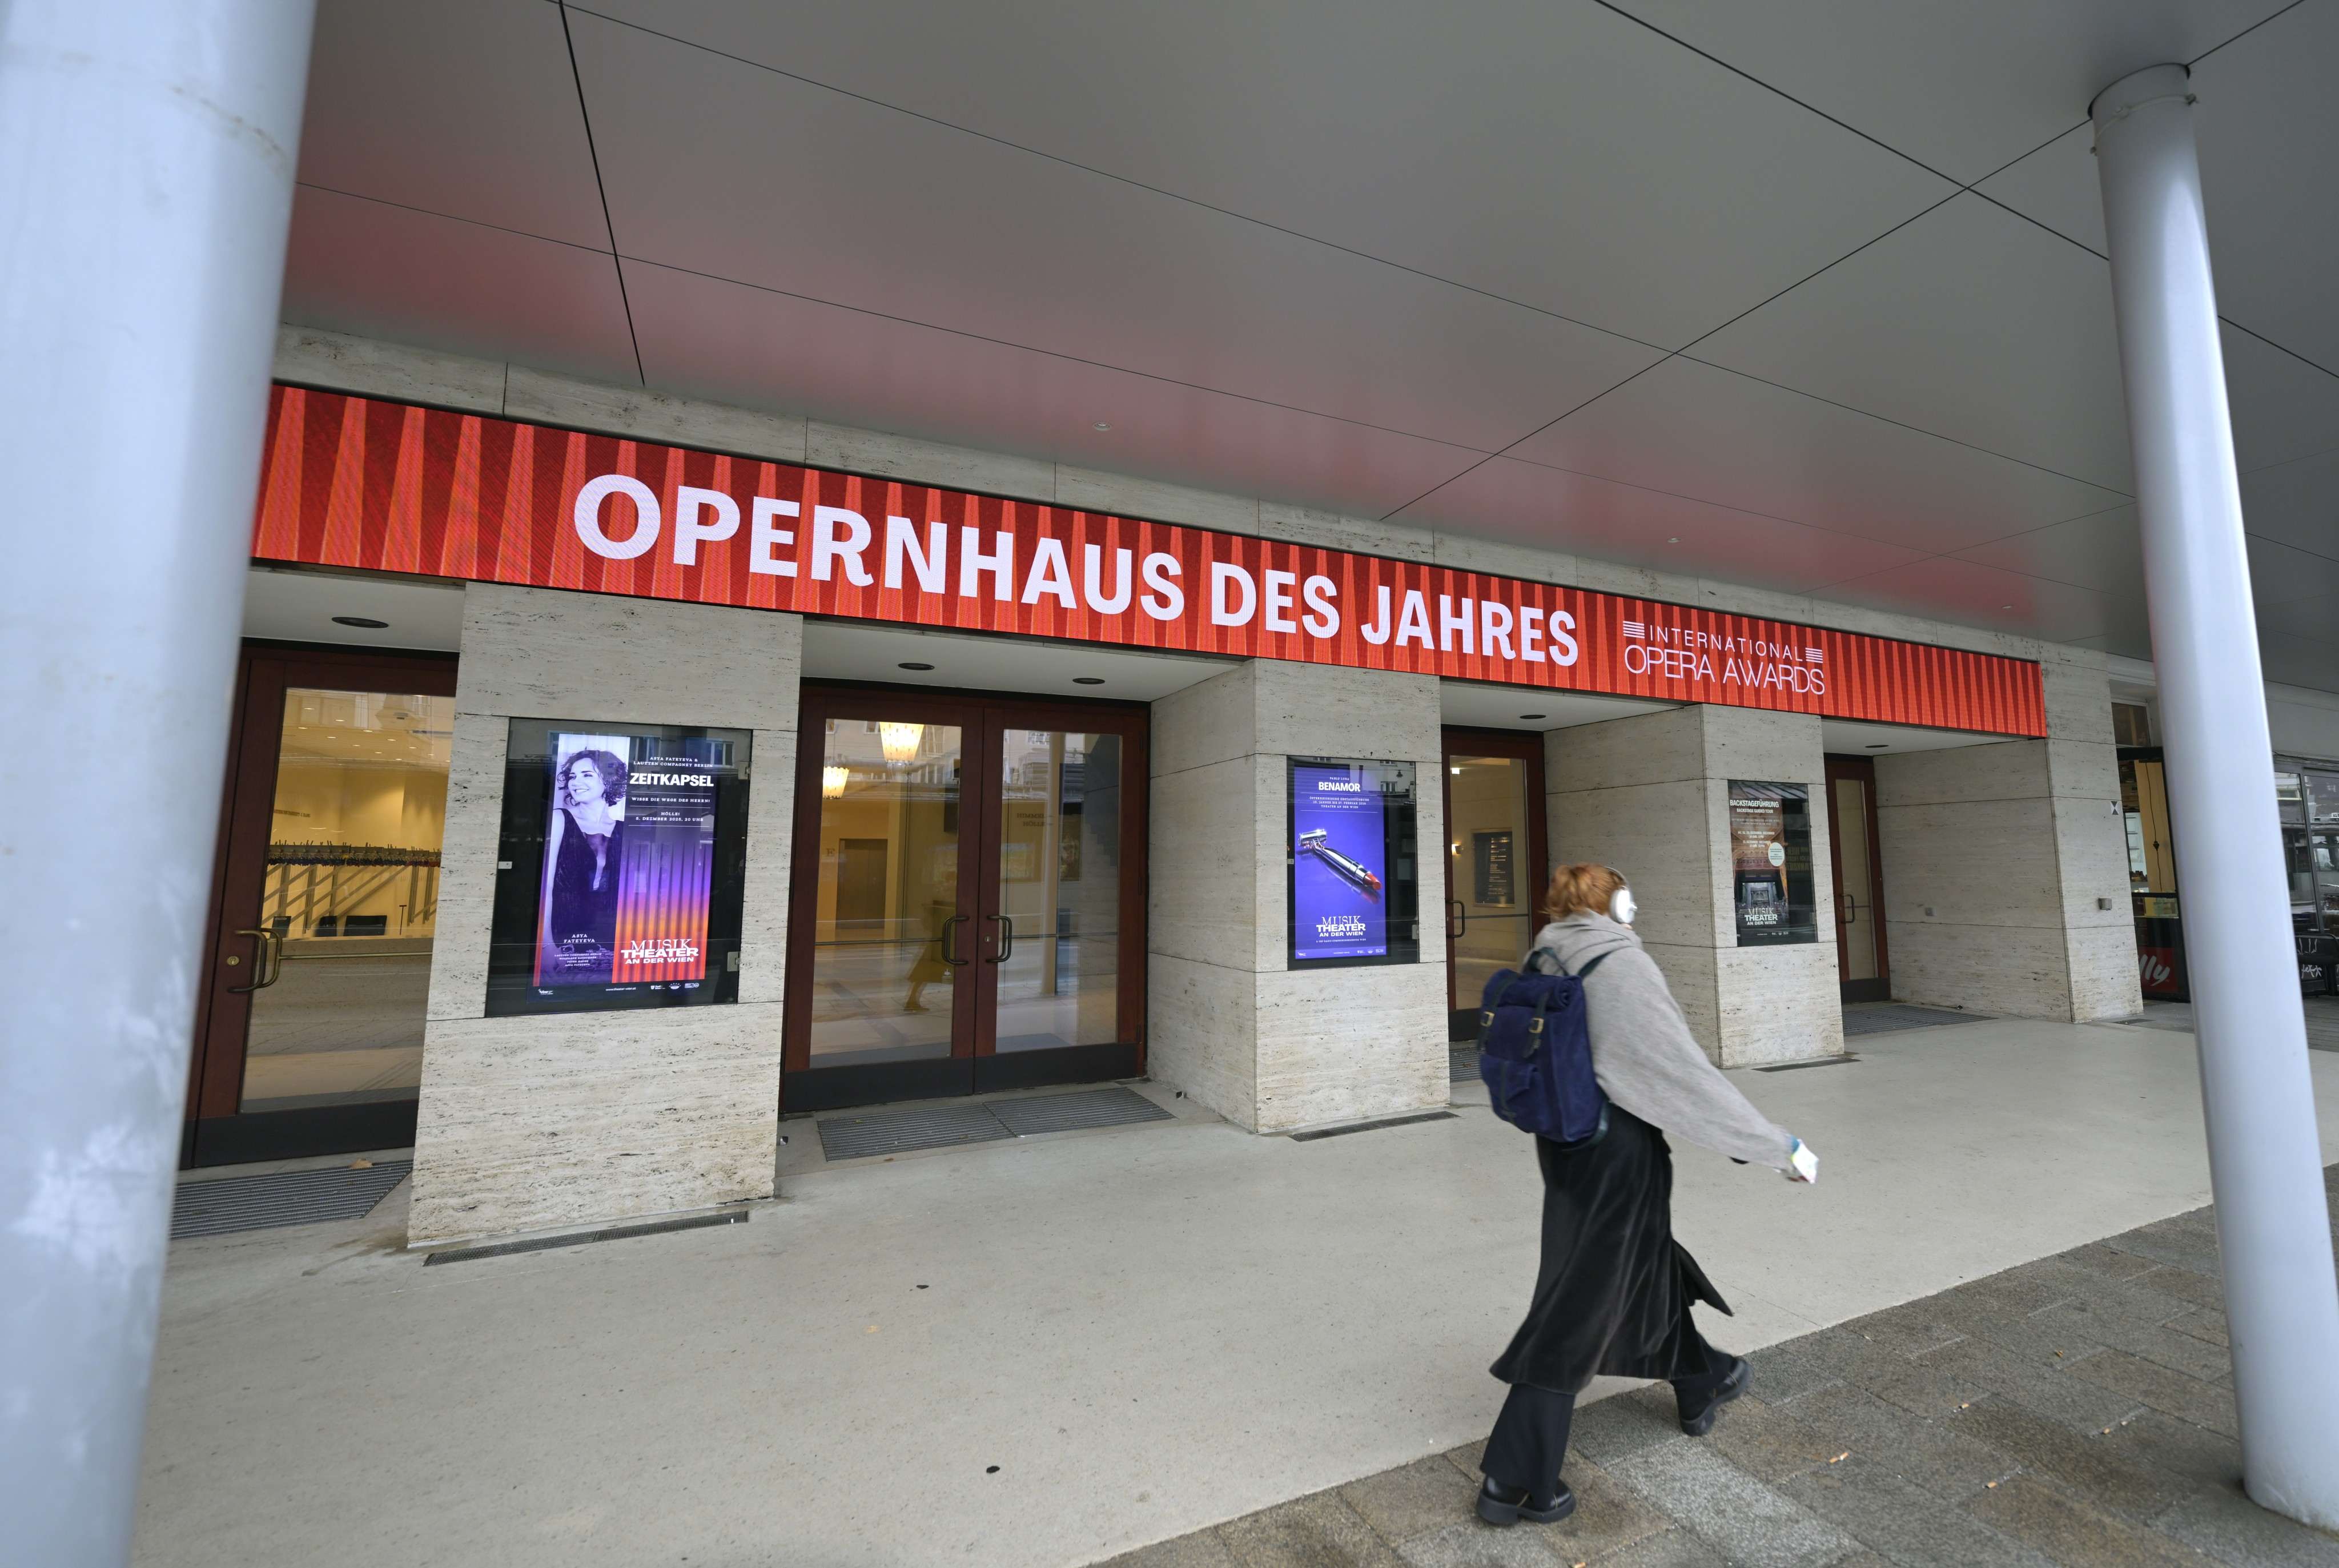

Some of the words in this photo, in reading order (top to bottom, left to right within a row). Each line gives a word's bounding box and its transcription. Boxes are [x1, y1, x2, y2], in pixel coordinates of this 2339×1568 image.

[574, 474, 1185, 621] OPERNHAUS
[1211, 561, 1340, 639] DES
[1361, 585, 1578, 667] JAHRES
[1650, 624, 1803, 662] INTERNATIONAL
[1624, 645, 1715, 682] OPERA
[1723, 657, 1826, 695] AWARDS
[629, 773, 714, 787] ZEITKAPSEL
[1319, 782, 1361, 792] BENAMOR
[1730, 799, 1779, 808] BACKSTAGEFÜHRUNG
[1316, 923, 1366, 932] THEATER
[1321, 916, 1361, 927] MUSIK
[631, 939, 692, 952] MUSIK
[621, 948, 699, 958] THEATER
[2138, 954, 2170, 986] lly
